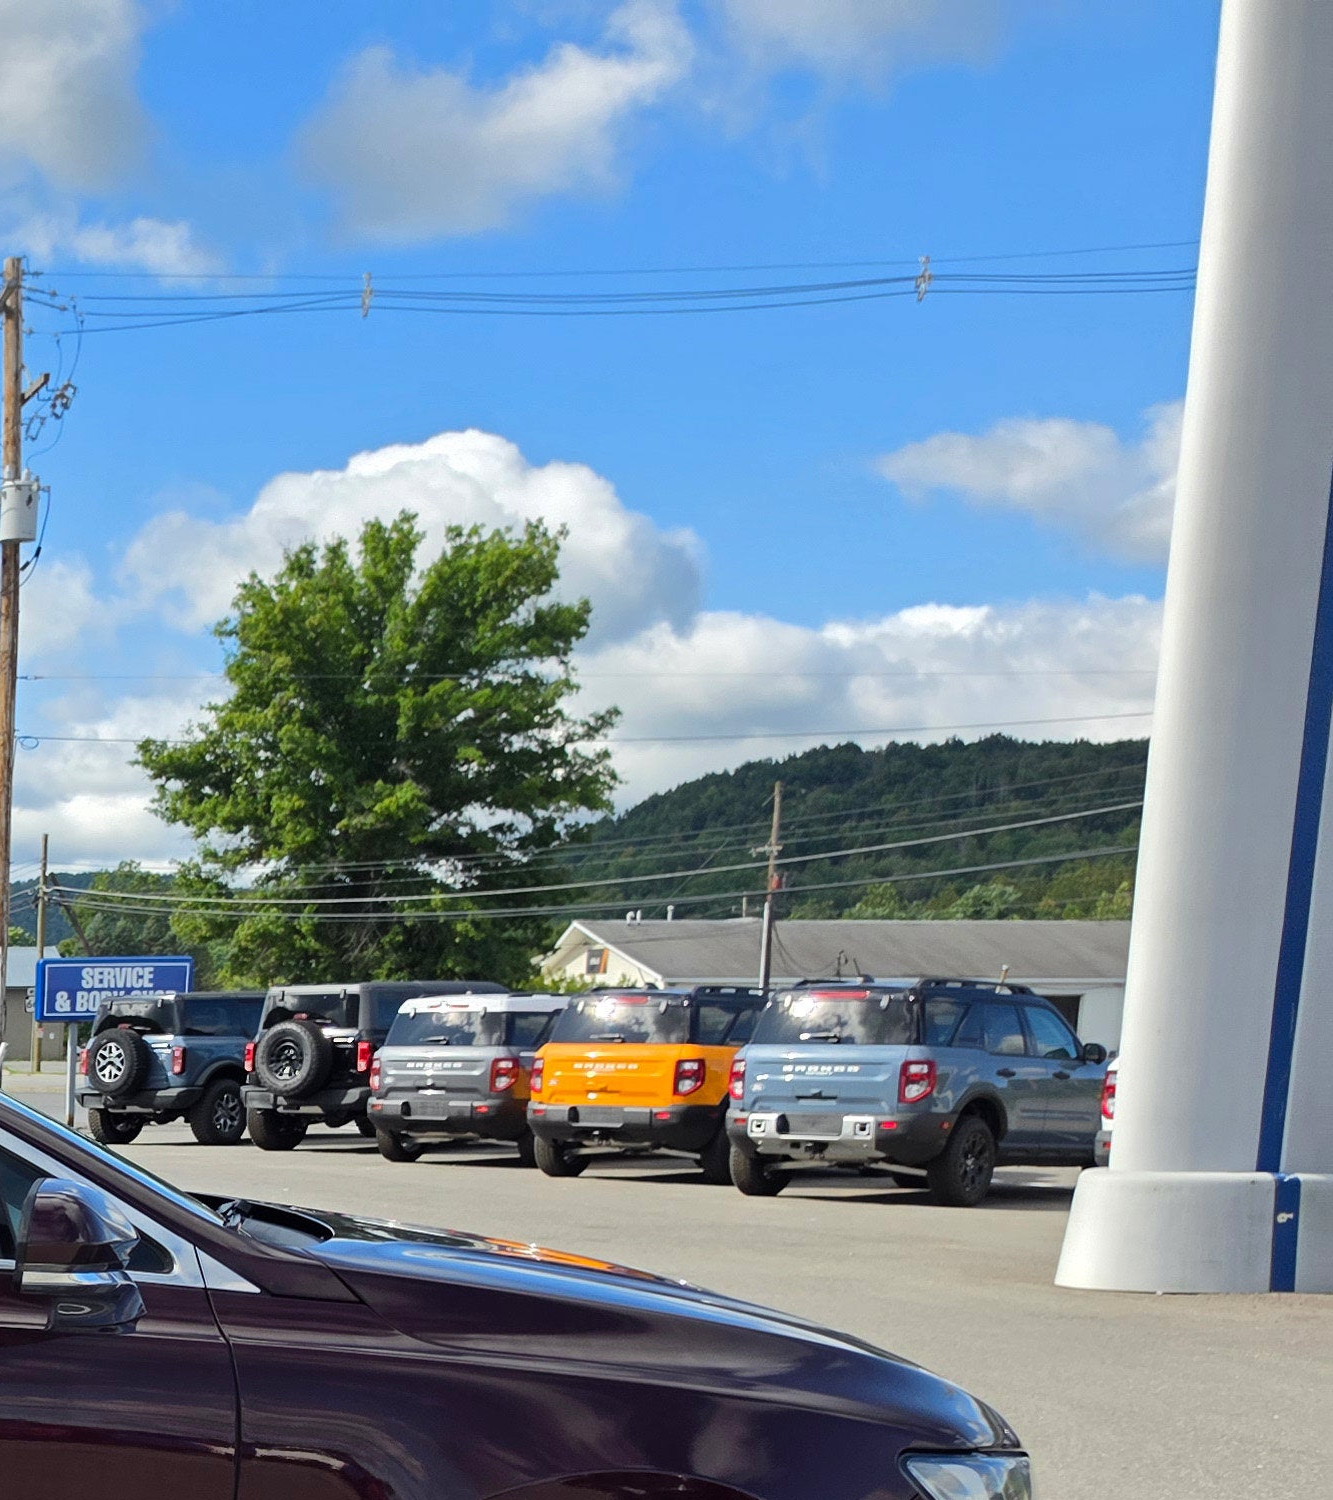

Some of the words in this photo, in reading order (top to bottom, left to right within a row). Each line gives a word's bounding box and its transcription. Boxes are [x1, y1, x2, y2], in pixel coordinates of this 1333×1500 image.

[81, 967, 154, 989] SERVICE
[54, 991, 71, 1012] &
[76, 991, 126, 1012] BO
